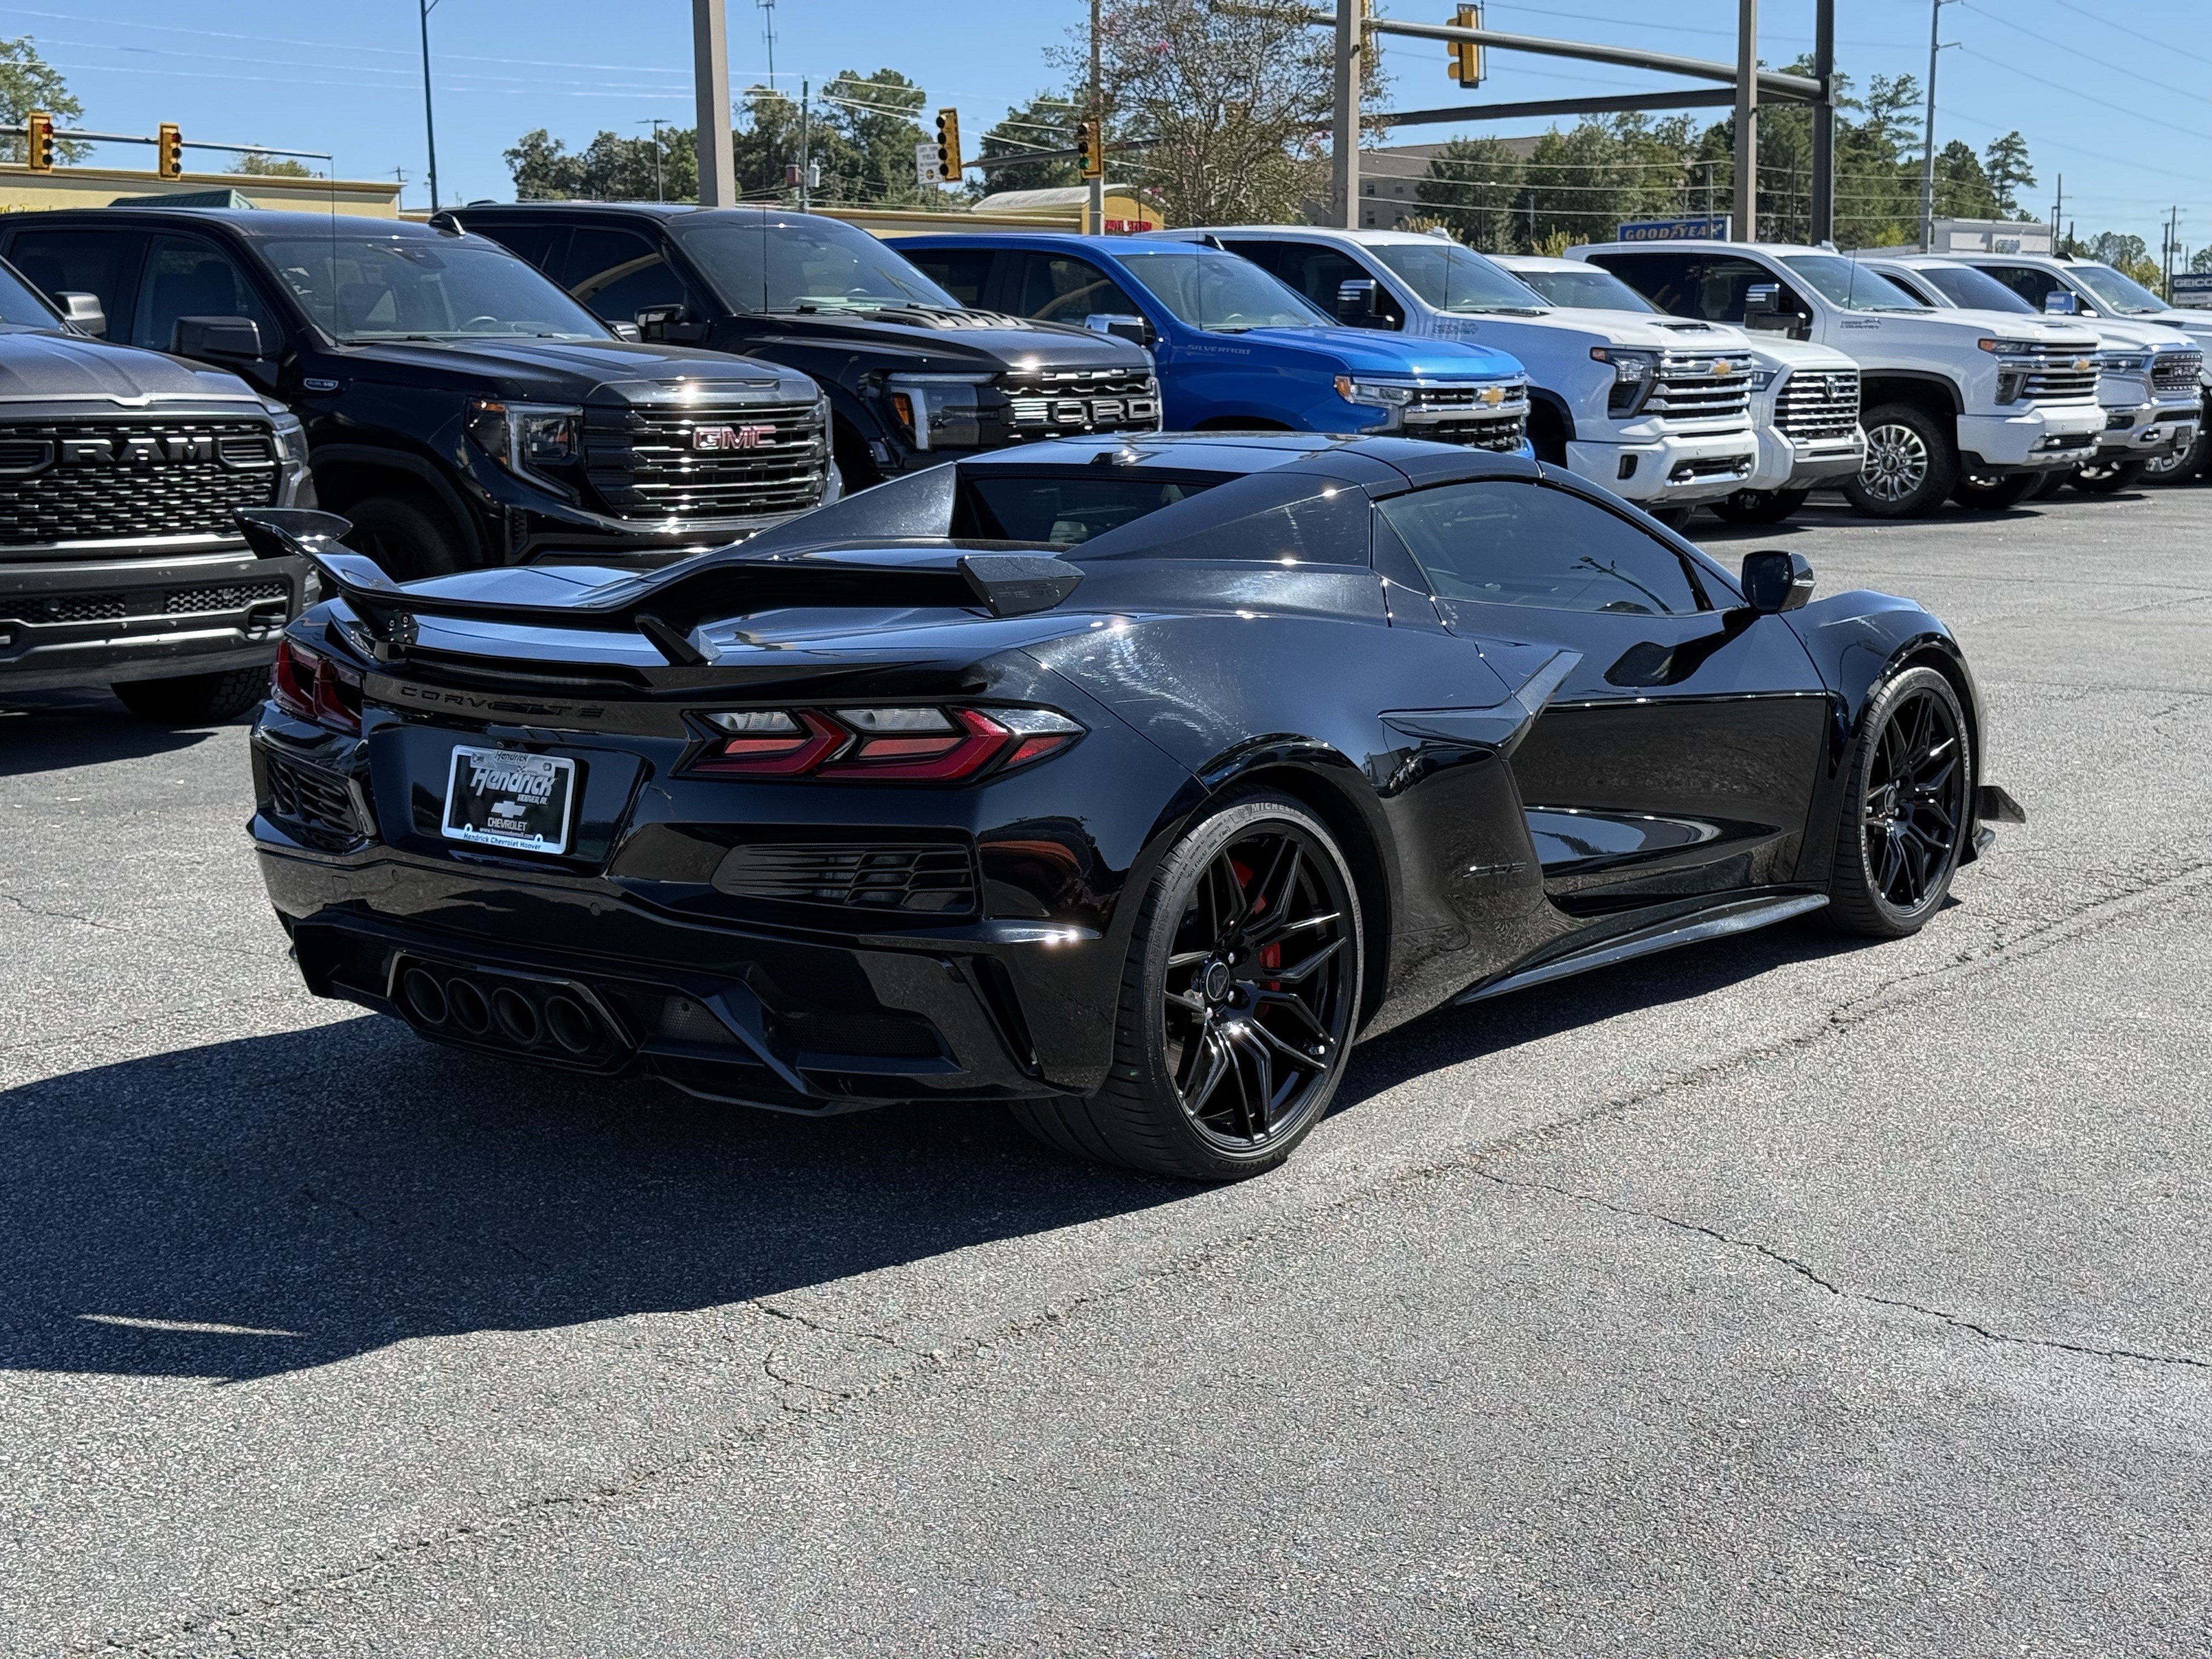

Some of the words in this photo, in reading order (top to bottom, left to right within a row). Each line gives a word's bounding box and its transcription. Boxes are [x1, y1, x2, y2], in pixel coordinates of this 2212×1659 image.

[62, 437, 212, 462] RAM
[692, 425, 776, 450] GMC
[400, 686, 605, 718] CORVETTE
[470, 768, 557, 797] Hendrick
[487, 817, 527, 831] CHEVROLET
[464, 832, 489, 842] Hendrick
[490, 837, 519, 847] Chevrolet
